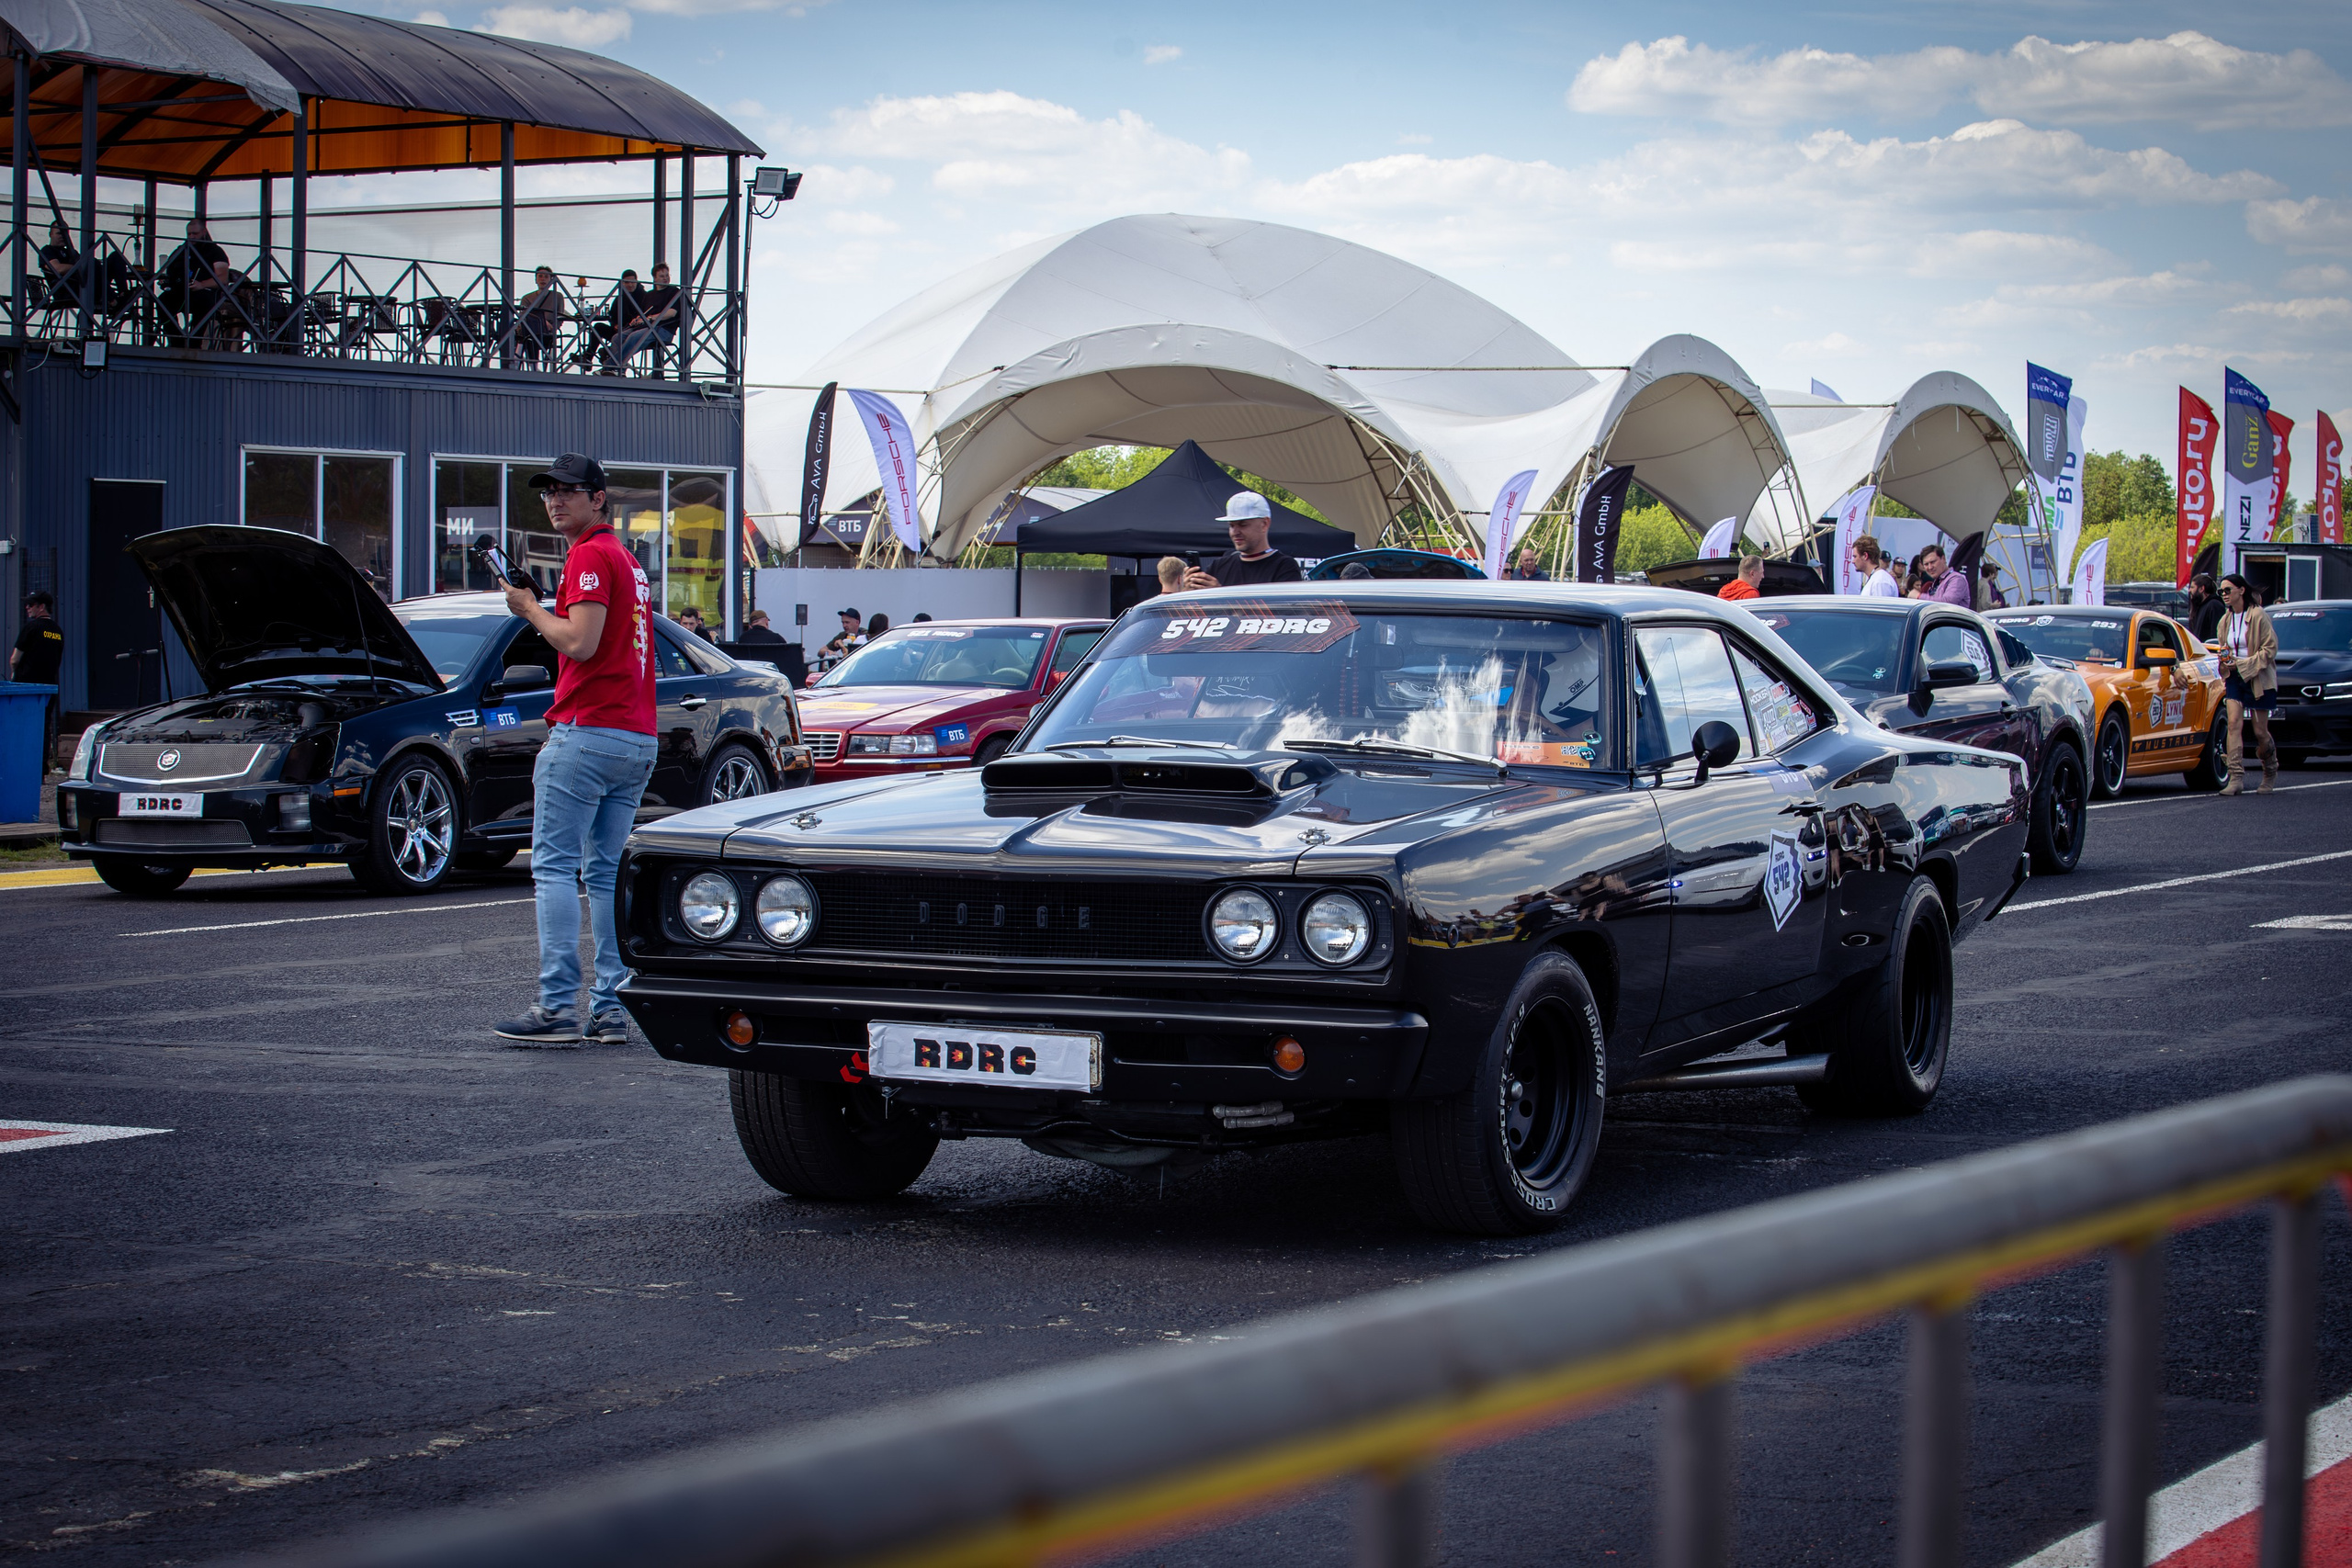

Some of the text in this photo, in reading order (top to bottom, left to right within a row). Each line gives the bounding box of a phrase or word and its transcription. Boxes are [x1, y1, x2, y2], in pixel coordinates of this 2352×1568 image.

[2242, 415, 2259, 468] Ganz
[876, 412, 911, 525] PORSCHE
[838, 520, 862, 533] ВТБ
[1595, 496, 1612, 536] GmbH
[2239, 496, 2251, 543] NEZI
[1497, 491, 1518, 580] ORSCHE
[1843, 506, 1858, 594] ORSCHE
[1161, 617, 1230, 638] 542
[2090, 621, 2117, 629] 293
[1569, 680, 1585, 694] OMP
[497, 713, 516, 726] ВТБ
[948, 728, 966, 741] ВТБ
[2145, 735, 2195, 750] MUSTANG
[137, 797, 183, 811] RDRC
[1772, 861, 1791, 896] 542
[919, 901, 1091, 930] DODGE
[912, 1038, 1036, 1076] RDRC
[1583, 1002, 1604, 1100] NANKANG
